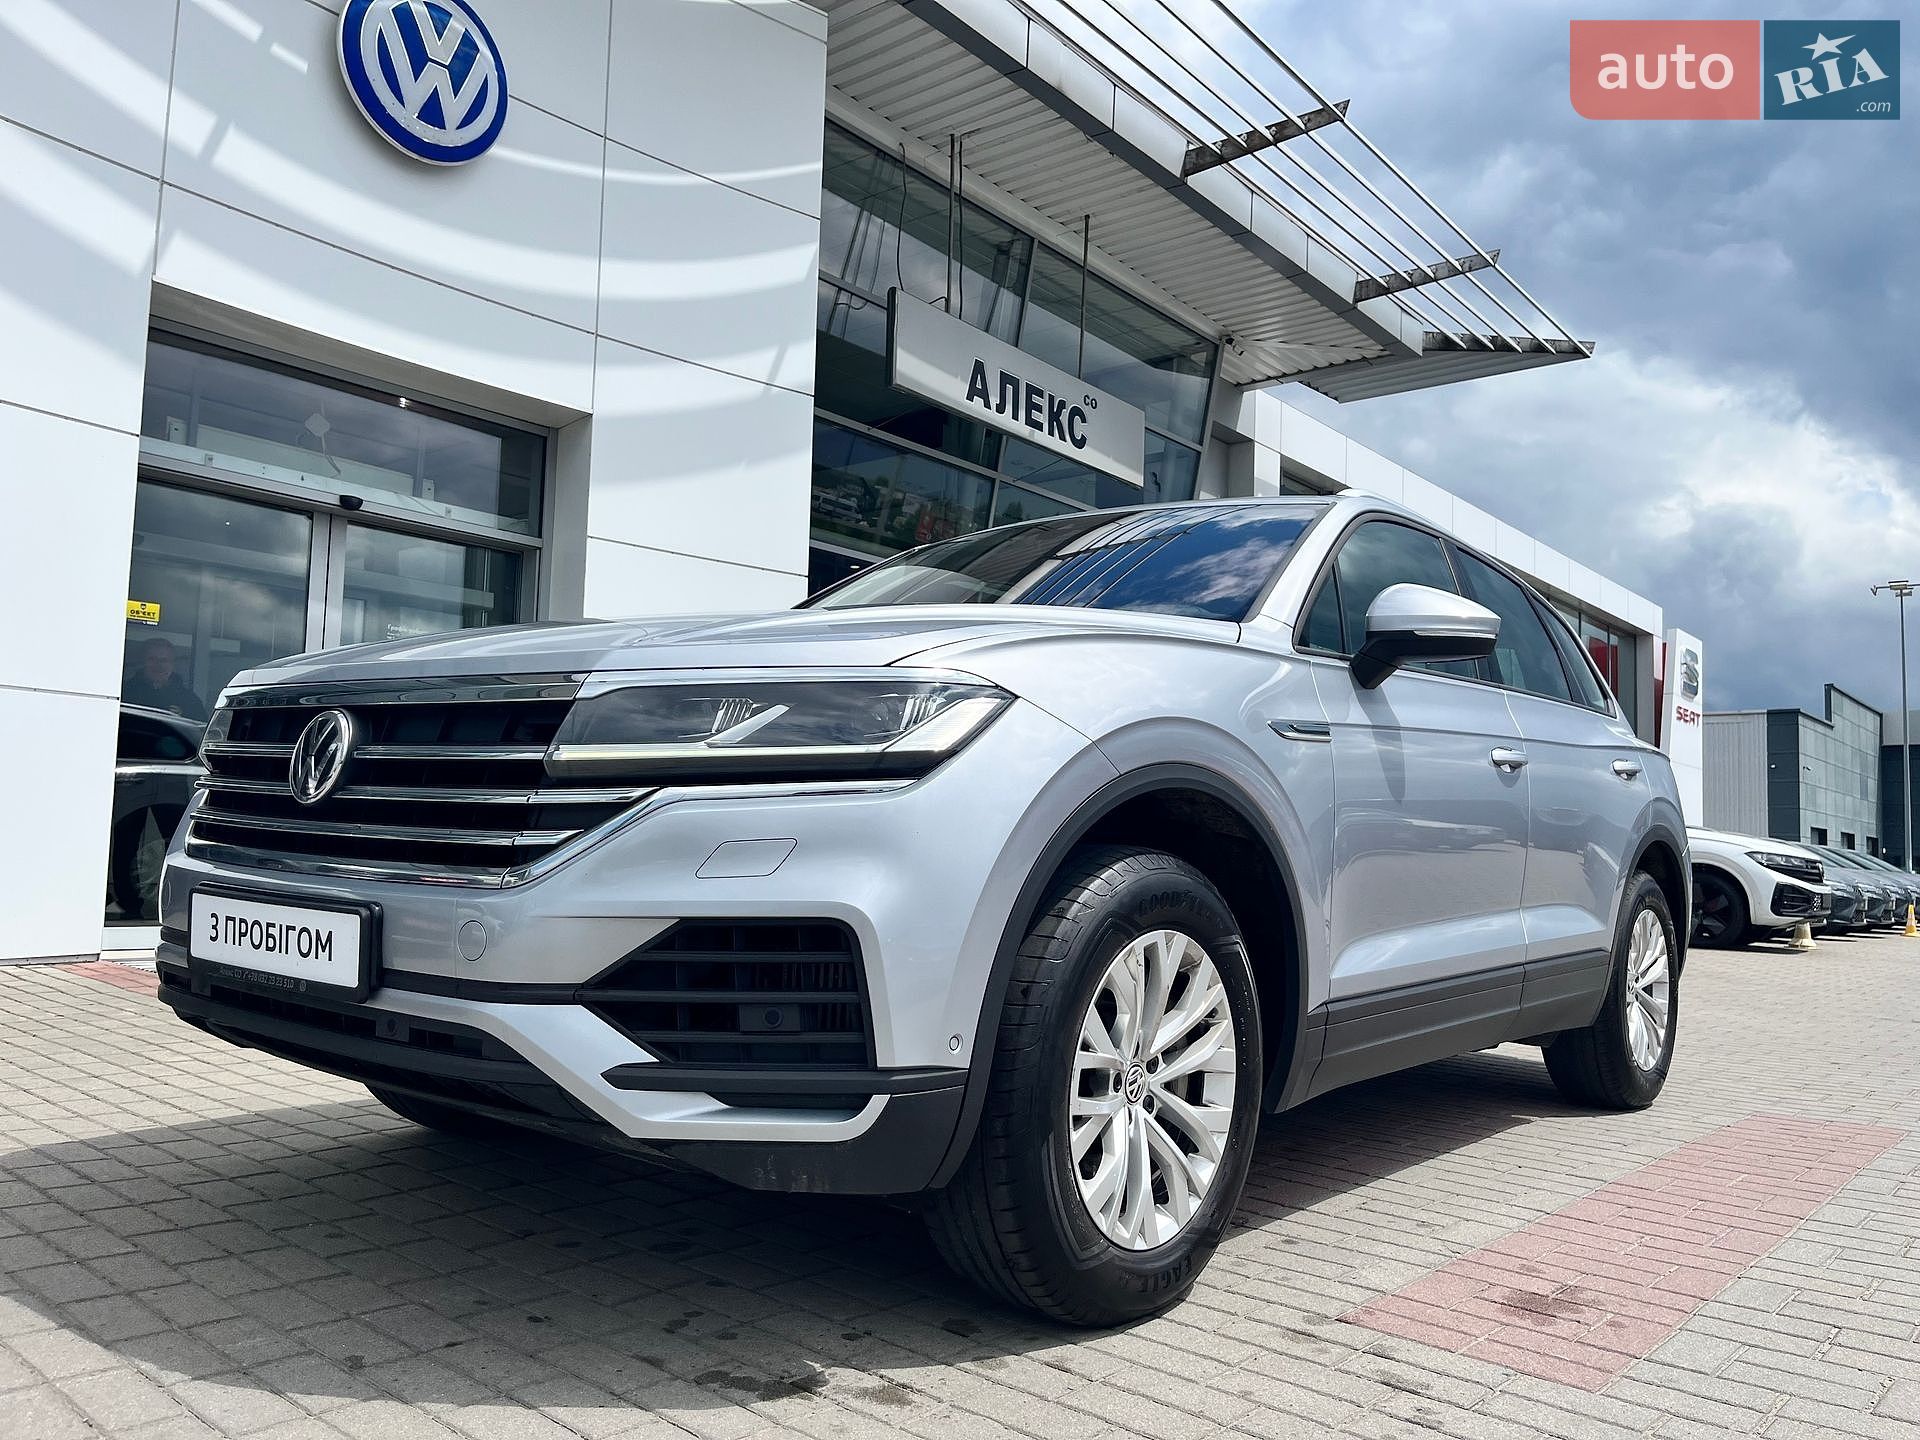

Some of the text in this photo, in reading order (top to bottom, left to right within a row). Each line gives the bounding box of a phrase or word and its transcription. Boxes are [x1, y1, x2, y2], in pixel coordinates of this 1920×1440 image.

[965, 357, 1089, 450] АЛЕКС
[1676, 705, 1701, 728] SEAT
[224, 916, 333, 962] ПРОБІГОМ
